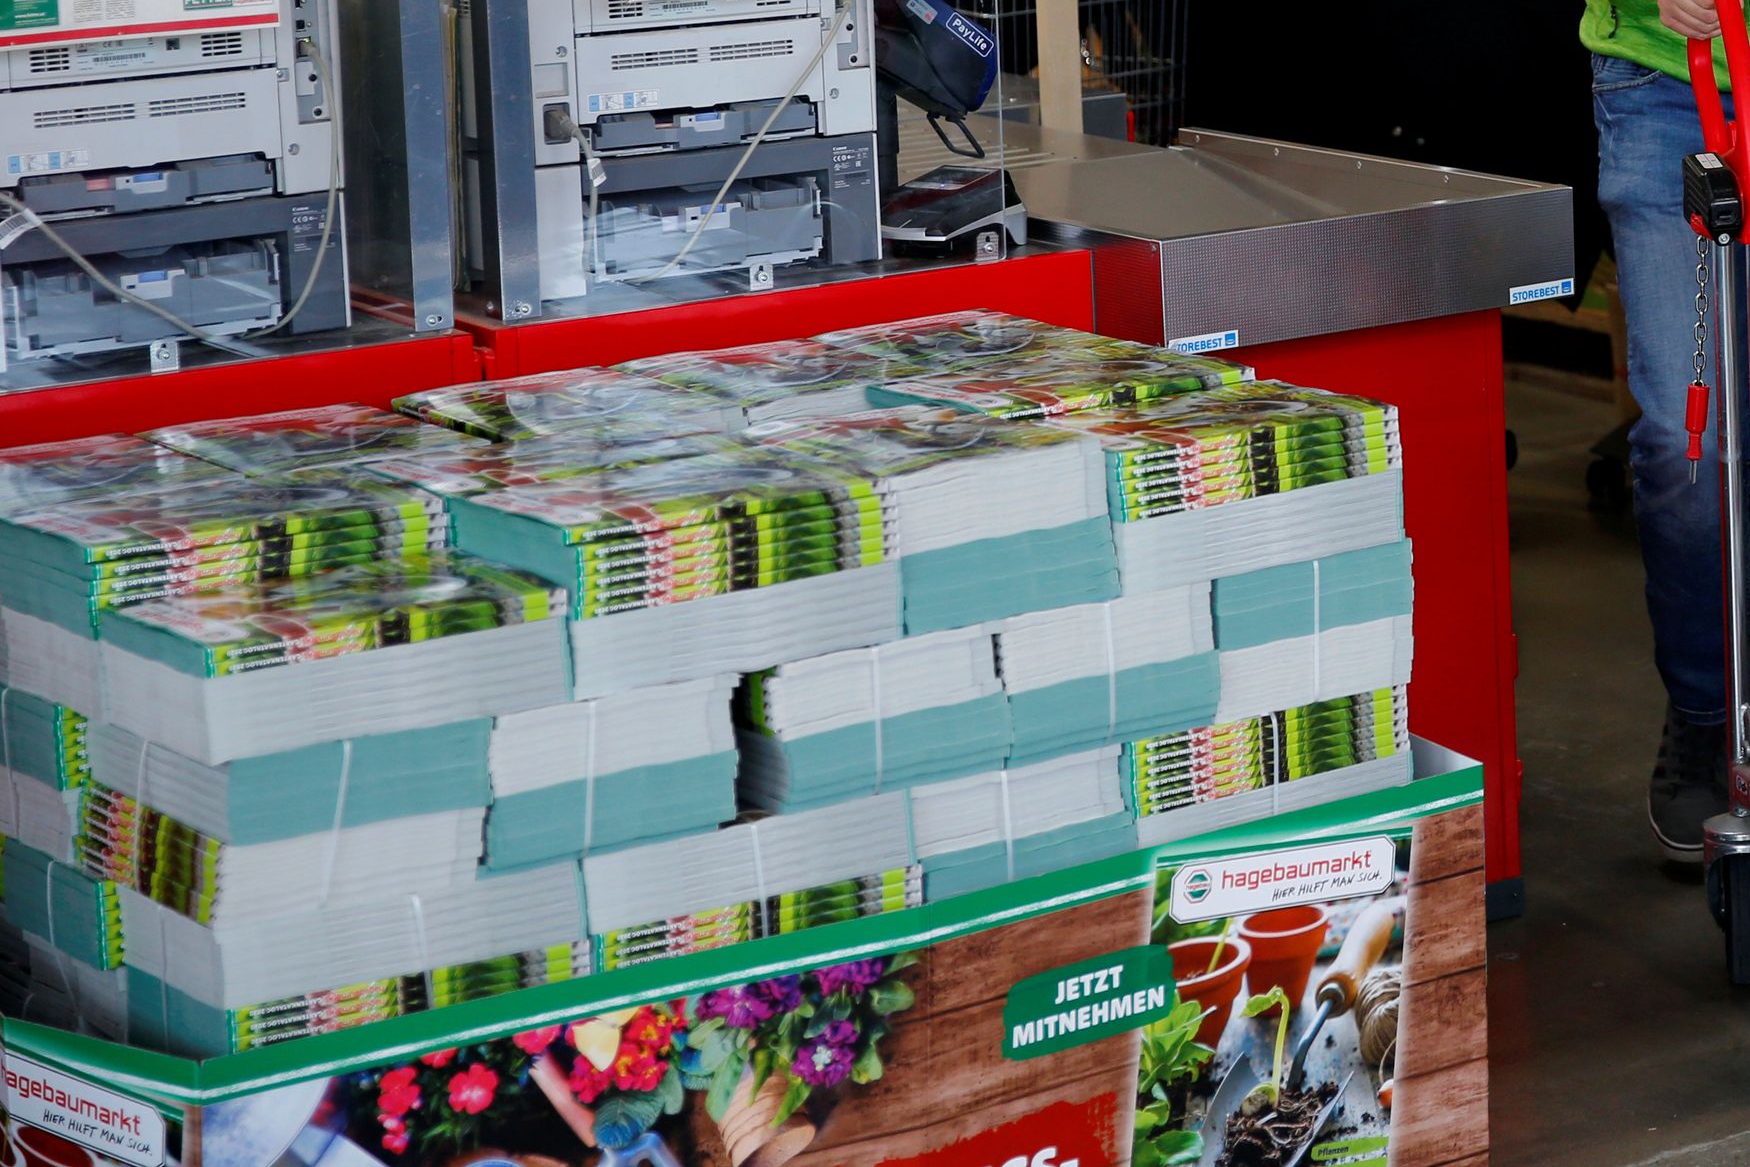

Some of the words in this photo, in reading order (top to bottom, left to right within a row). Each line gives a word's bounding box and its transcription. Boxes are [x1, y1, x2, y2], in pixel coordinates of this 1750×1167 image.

[952, 17, 988, 51] PayLife
[1511, 284, 1560, 304] STOREBEST
[1174, 335, 1223, 353] TOREBEST
[1012, 405, 1057, 419] GARTENKATALOG
[1147, 447, 1192, 459] GARTENKATALOG
[1152, 502, 1197, 515] GARTENKATALOG
[598, 522, 649, 535] GARTENKATALOG
[131, 557, 187, 571] GARTENKATALOG
[611, 554, 664, 568] GARTENKATALOG
[244, 638, 302, 654] GARTENKATALOG
[1159, 733, 1203, 746] GARTENKATALOG
[1163, 794, 1209, 808] GARTENKATALOG
[1222, 850, 1372, 890] hagebaumarkt
[1272, 887, 1295, 902] HIER
[1298, 880, 1328, 896] HILFT
[1330, 874, 1355, 887] MAN
[1357, 869, 1383, 882] SICH.
[631, 922, 686, 937] GARTENKATALOG
[1055, 964, 1124, 1005] JETZT
[267, 998, 324, 1013] GARTENKATALOG
[1011, 984, 1166, 1050] MITNEHMEN
[43, 1108, 65, 1125] HIER
[68, 1117, 98, 1139] HILFT
[100, 1128, 125, 1146] MAN
[127, 1136, 152, 1156] SICH.
[1316, 1143, 1350, 1158] Pflanzen
